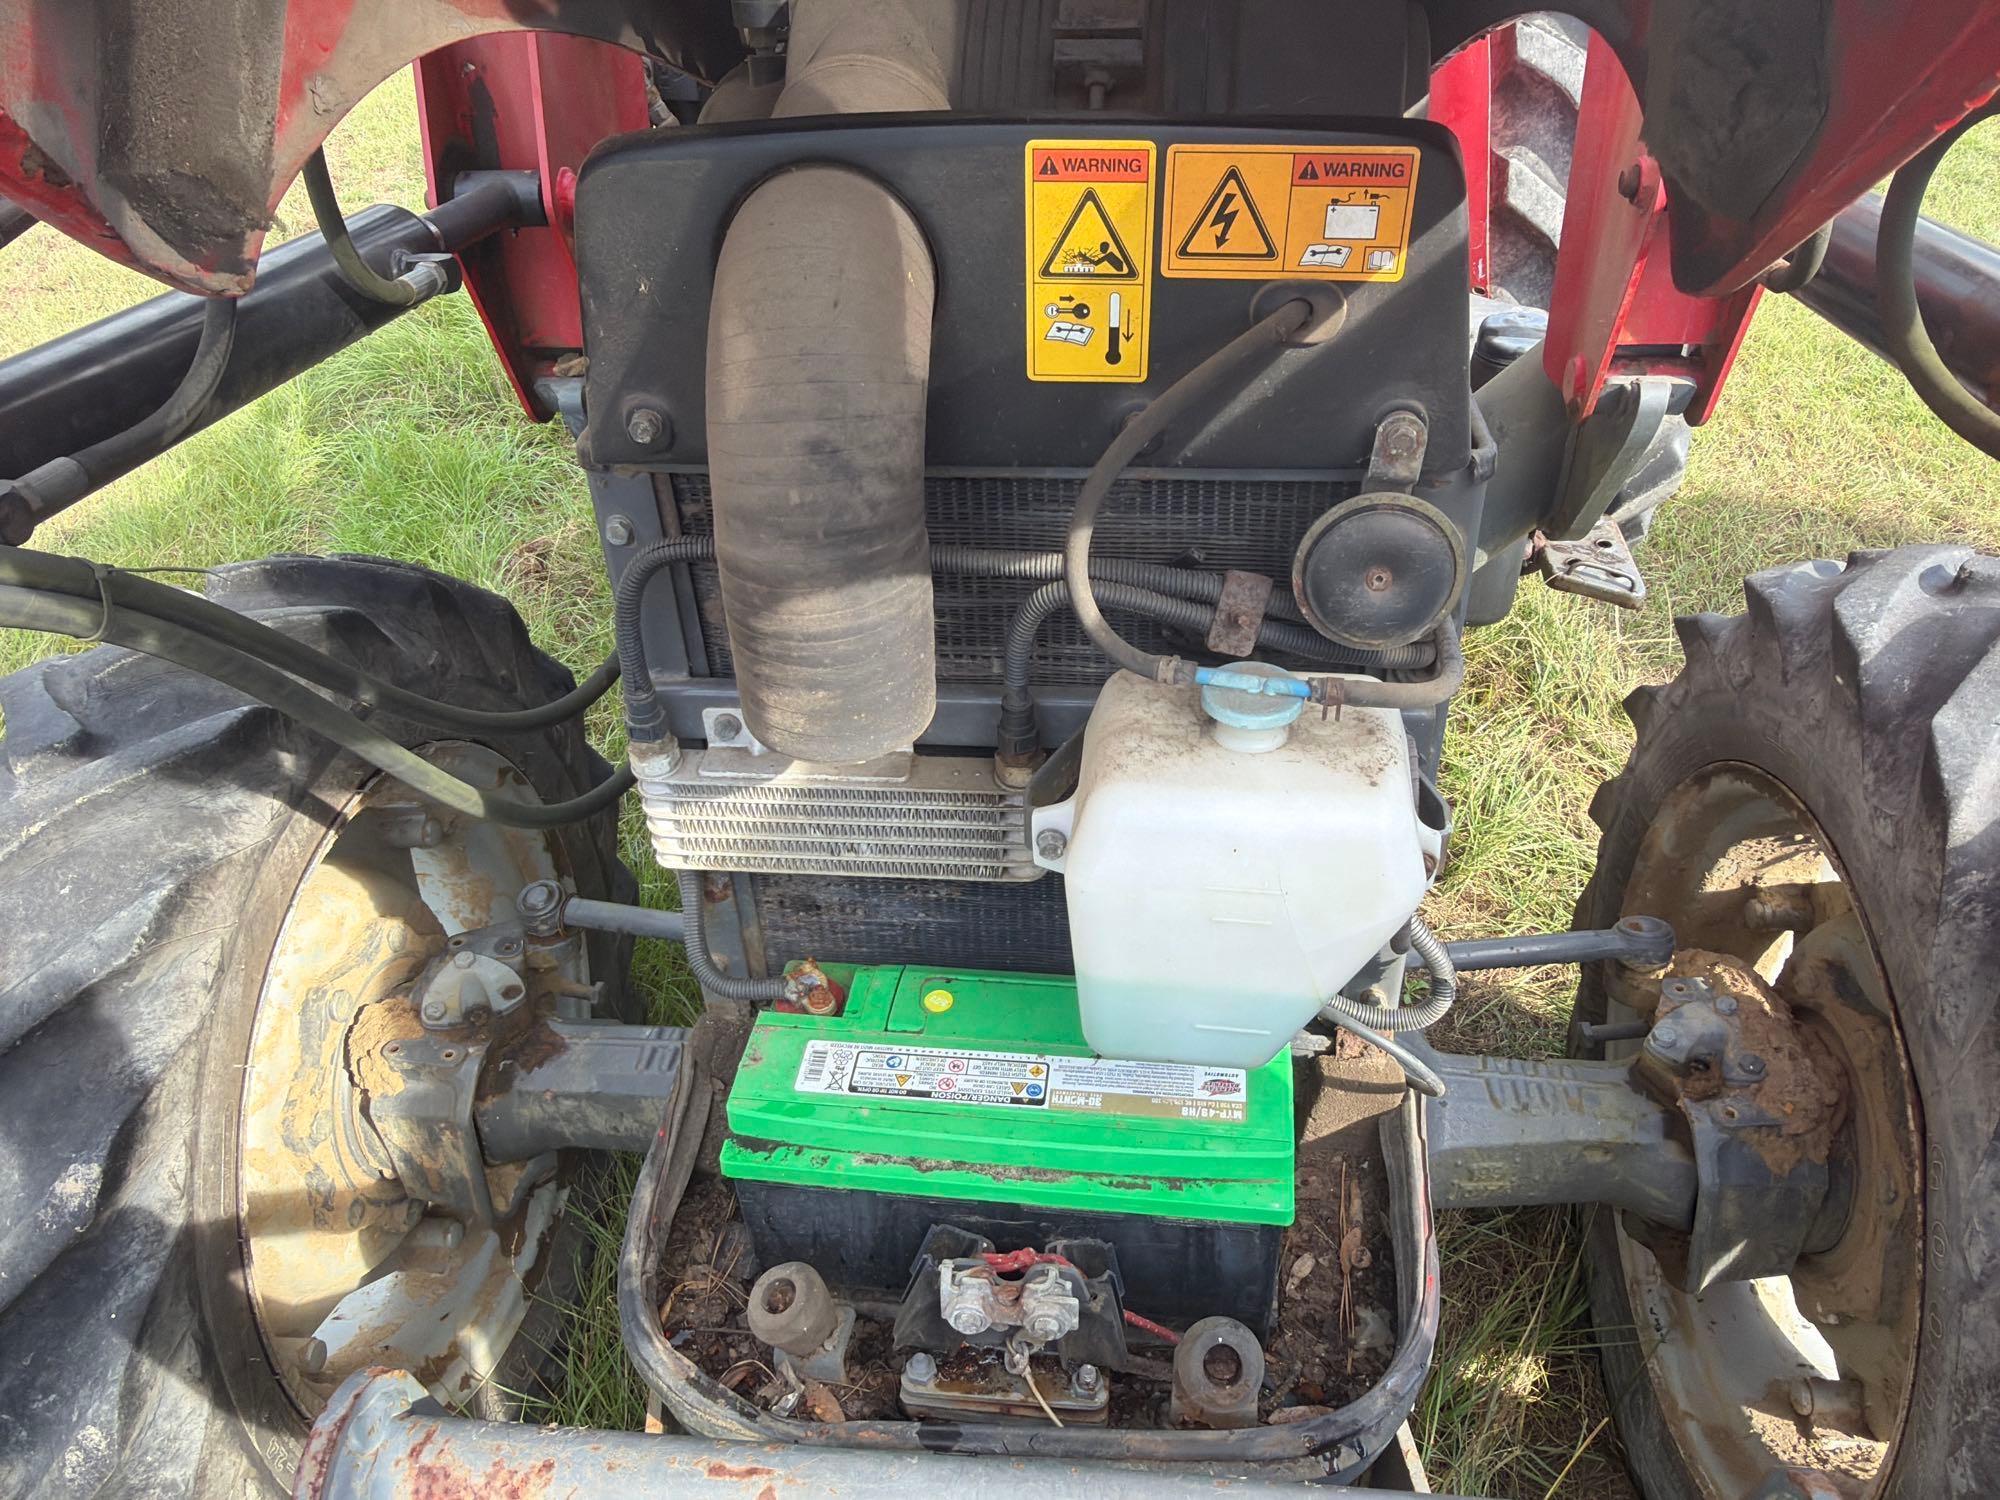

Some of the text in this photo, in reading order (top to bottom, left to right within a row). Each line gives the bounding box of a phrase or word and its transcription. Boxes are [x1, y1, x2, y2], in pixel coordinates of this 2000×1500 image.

[1062, 158, 1142, 174] WARNING
[1324, 162, 1405, 179] WARNING
[930, 1091, 1010, 1103] DANGER/POISON
[1051, 1094, 1102, 1106] 30-MONTH
